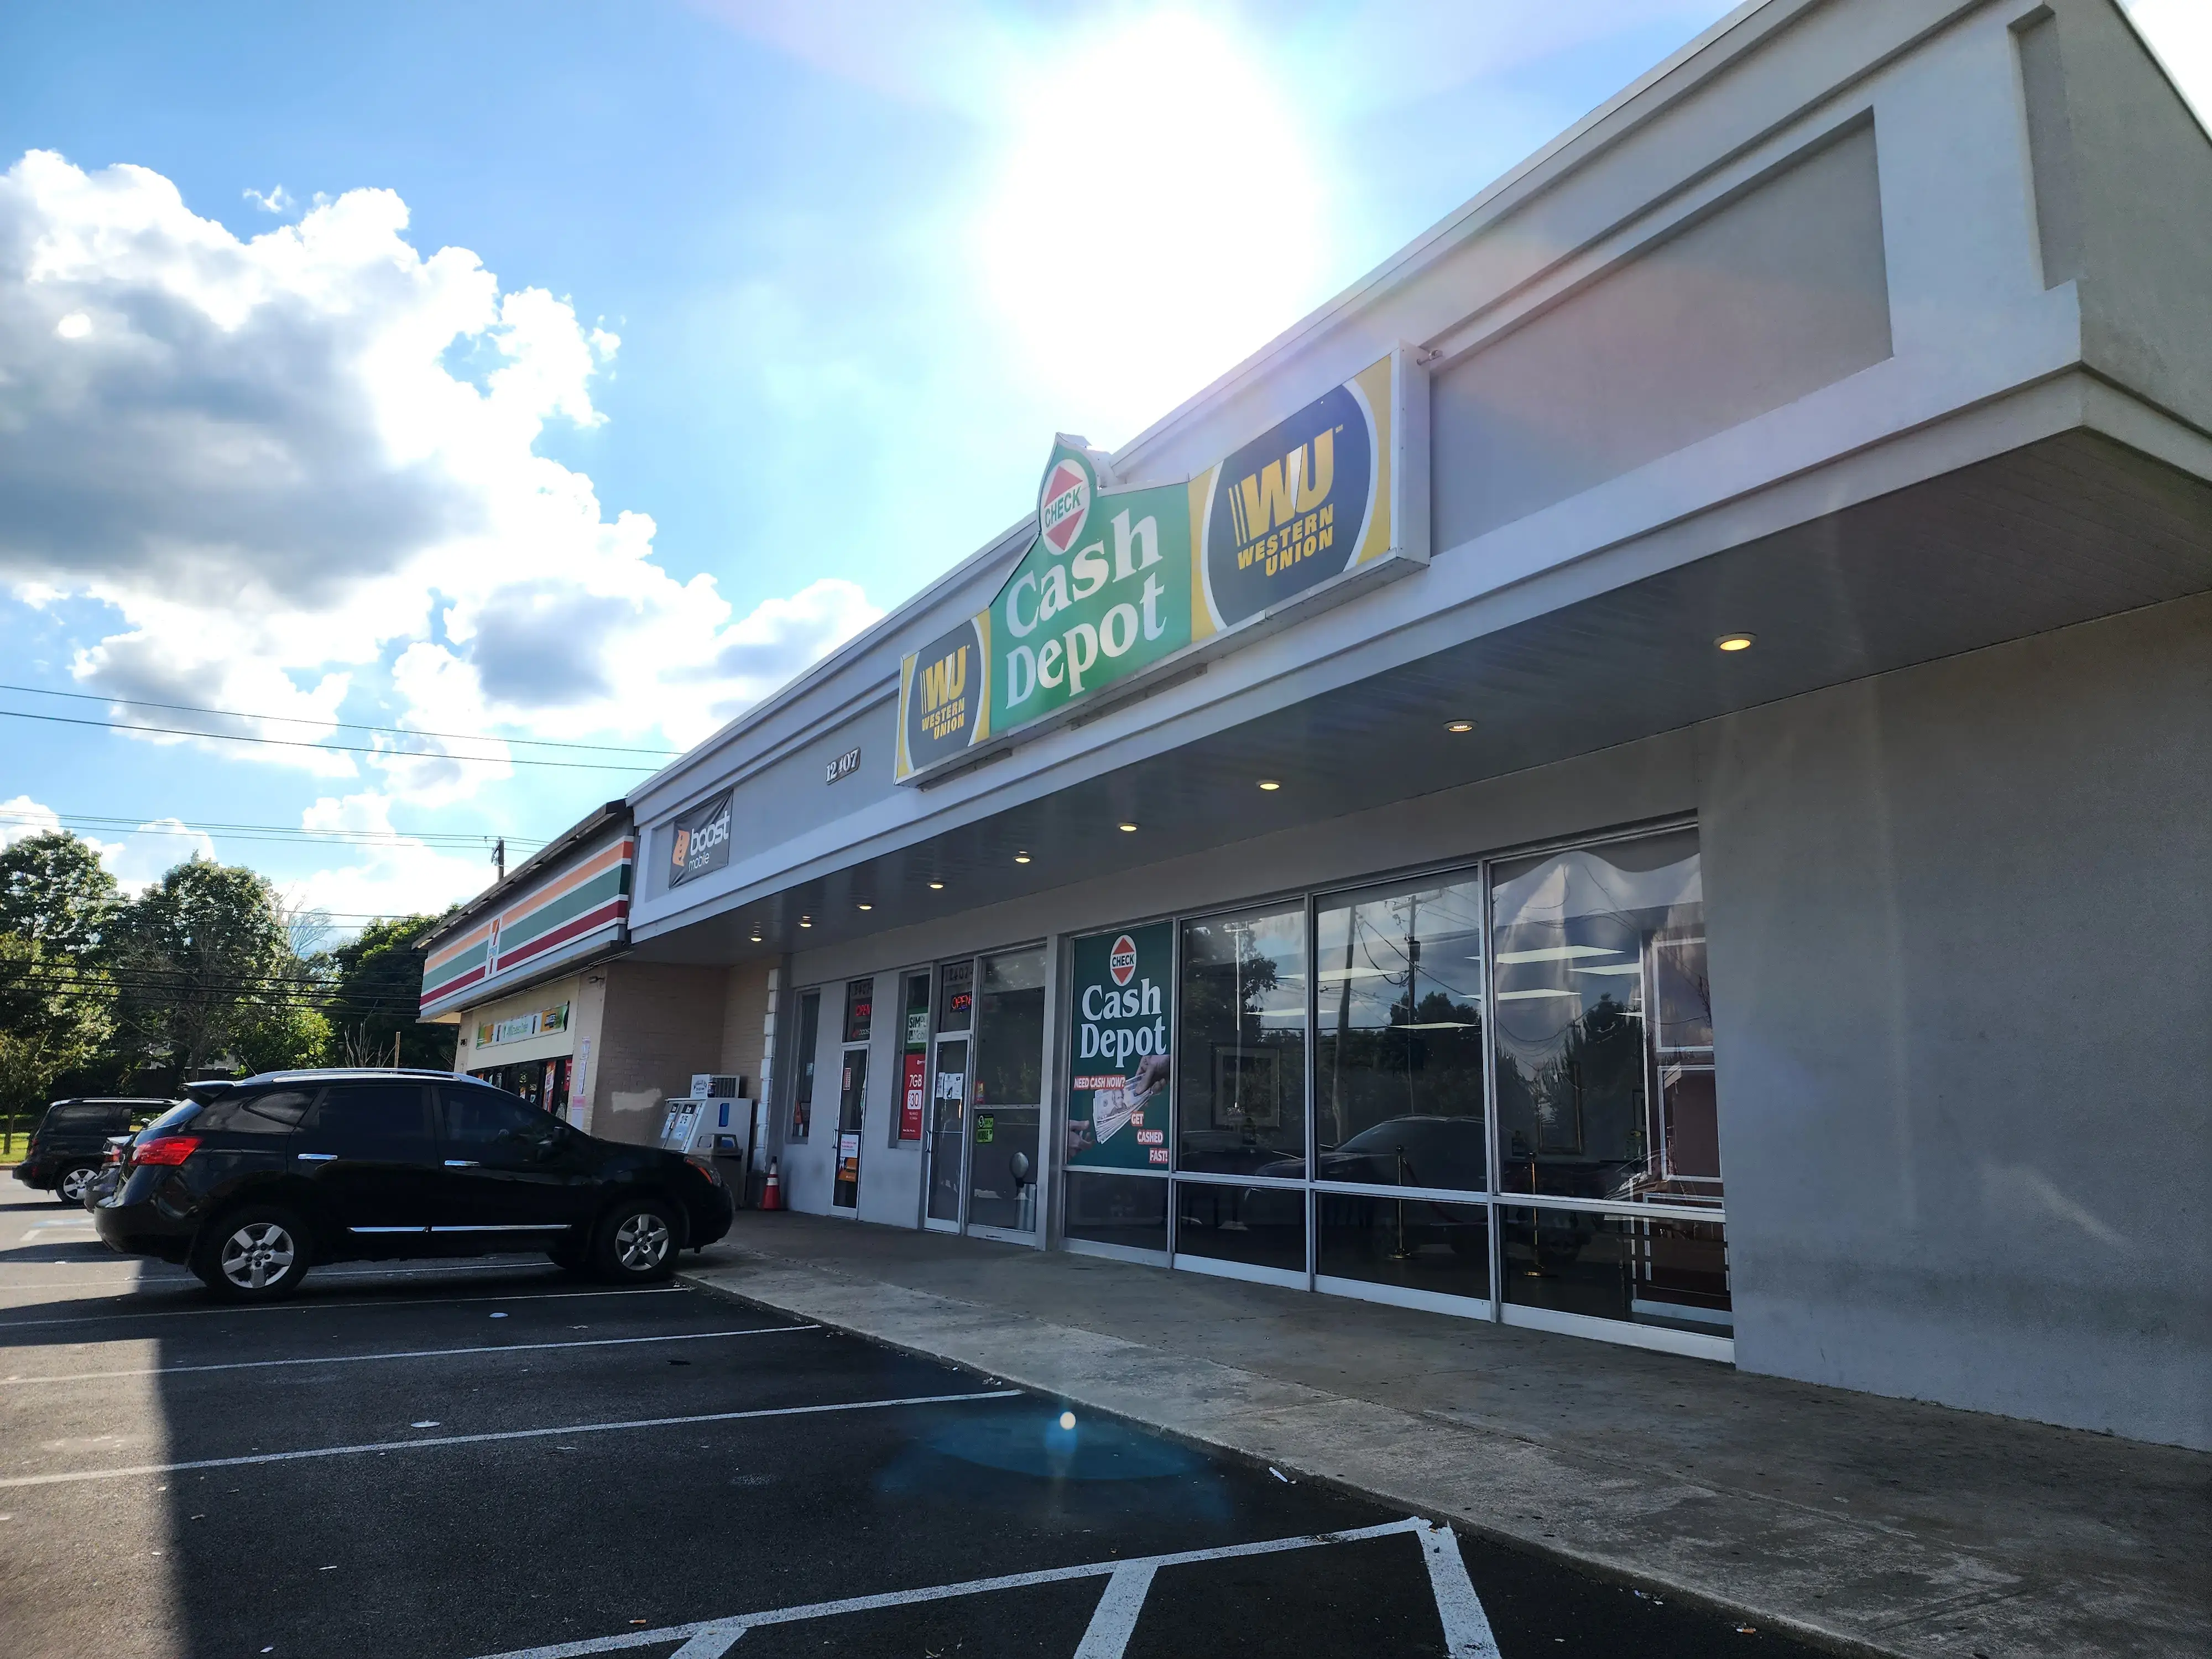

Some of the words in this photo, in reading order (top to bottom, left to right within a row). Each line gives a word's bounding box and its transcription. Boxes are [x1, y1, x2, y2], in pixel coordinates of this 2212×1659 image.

[1045, 486, 1081, 528] CHECK
[1237, 503, 1333, 570] WESTERN
[1266, 526, 1333, 576] UNION
[1006, 508, 1163, 638] Cash
[1005, 572, 1167, 709] Depot
[922, 697, 965, 731] WESTERN
[933, 712, 964, 740] UNION
[826, 749, 858, 781] 12407
[690, 810, 730, 855] boost
[688, 851, 710, 872] mobile
[1112, 953, 1134, 967] CHECK
[1082, 978, 1162, 1021] Cash
[1080, 1016, 1167, 1068] Depot
[909, 1074, 922, 1088] 7GB
[1074, 1078, 1089, 1088] NEED
[1090, 1077, 1105, 1088] CASH
[1106, 1076, 1125, 1087] NOW?
[1131, 1113, 1144, 1125] GET
[1137, 1131, 1163, 1143] CASHED
[1149, 1150, 1168, 1162] FAST!
